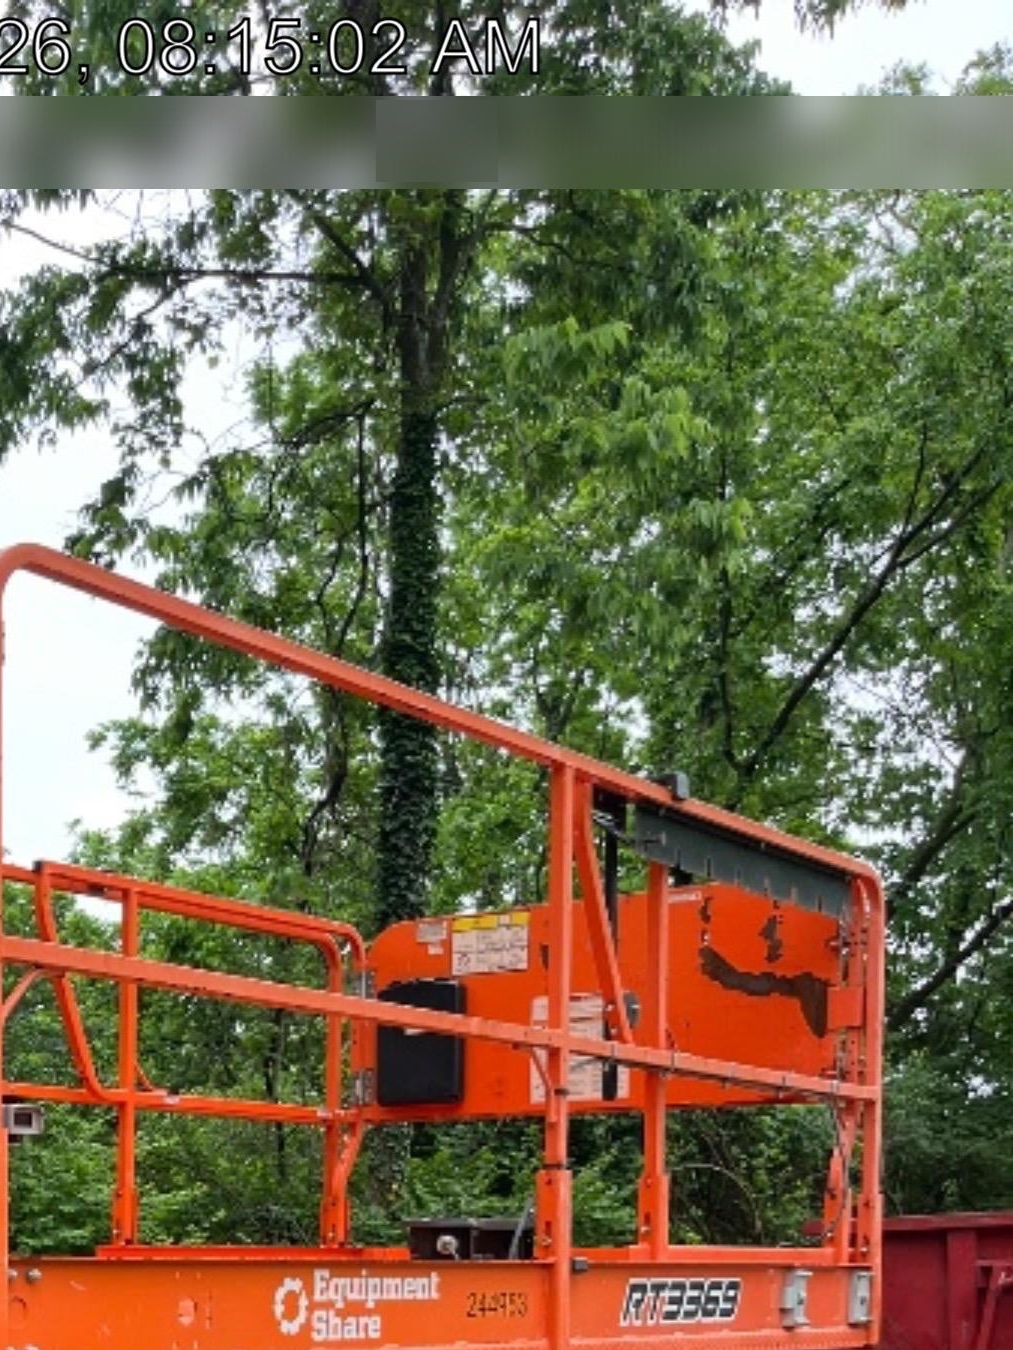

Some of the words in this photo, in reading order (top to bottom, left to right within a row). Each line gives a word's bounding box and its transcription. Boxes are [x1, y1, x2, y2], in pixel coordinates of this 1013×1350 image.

[314, 1268, 440, 1309] Equipment
[466, 1291, 529, 1318] 244953
[619, 1277, 743, 1327] RT3369
[311, 1309, 381, 1342] Share
